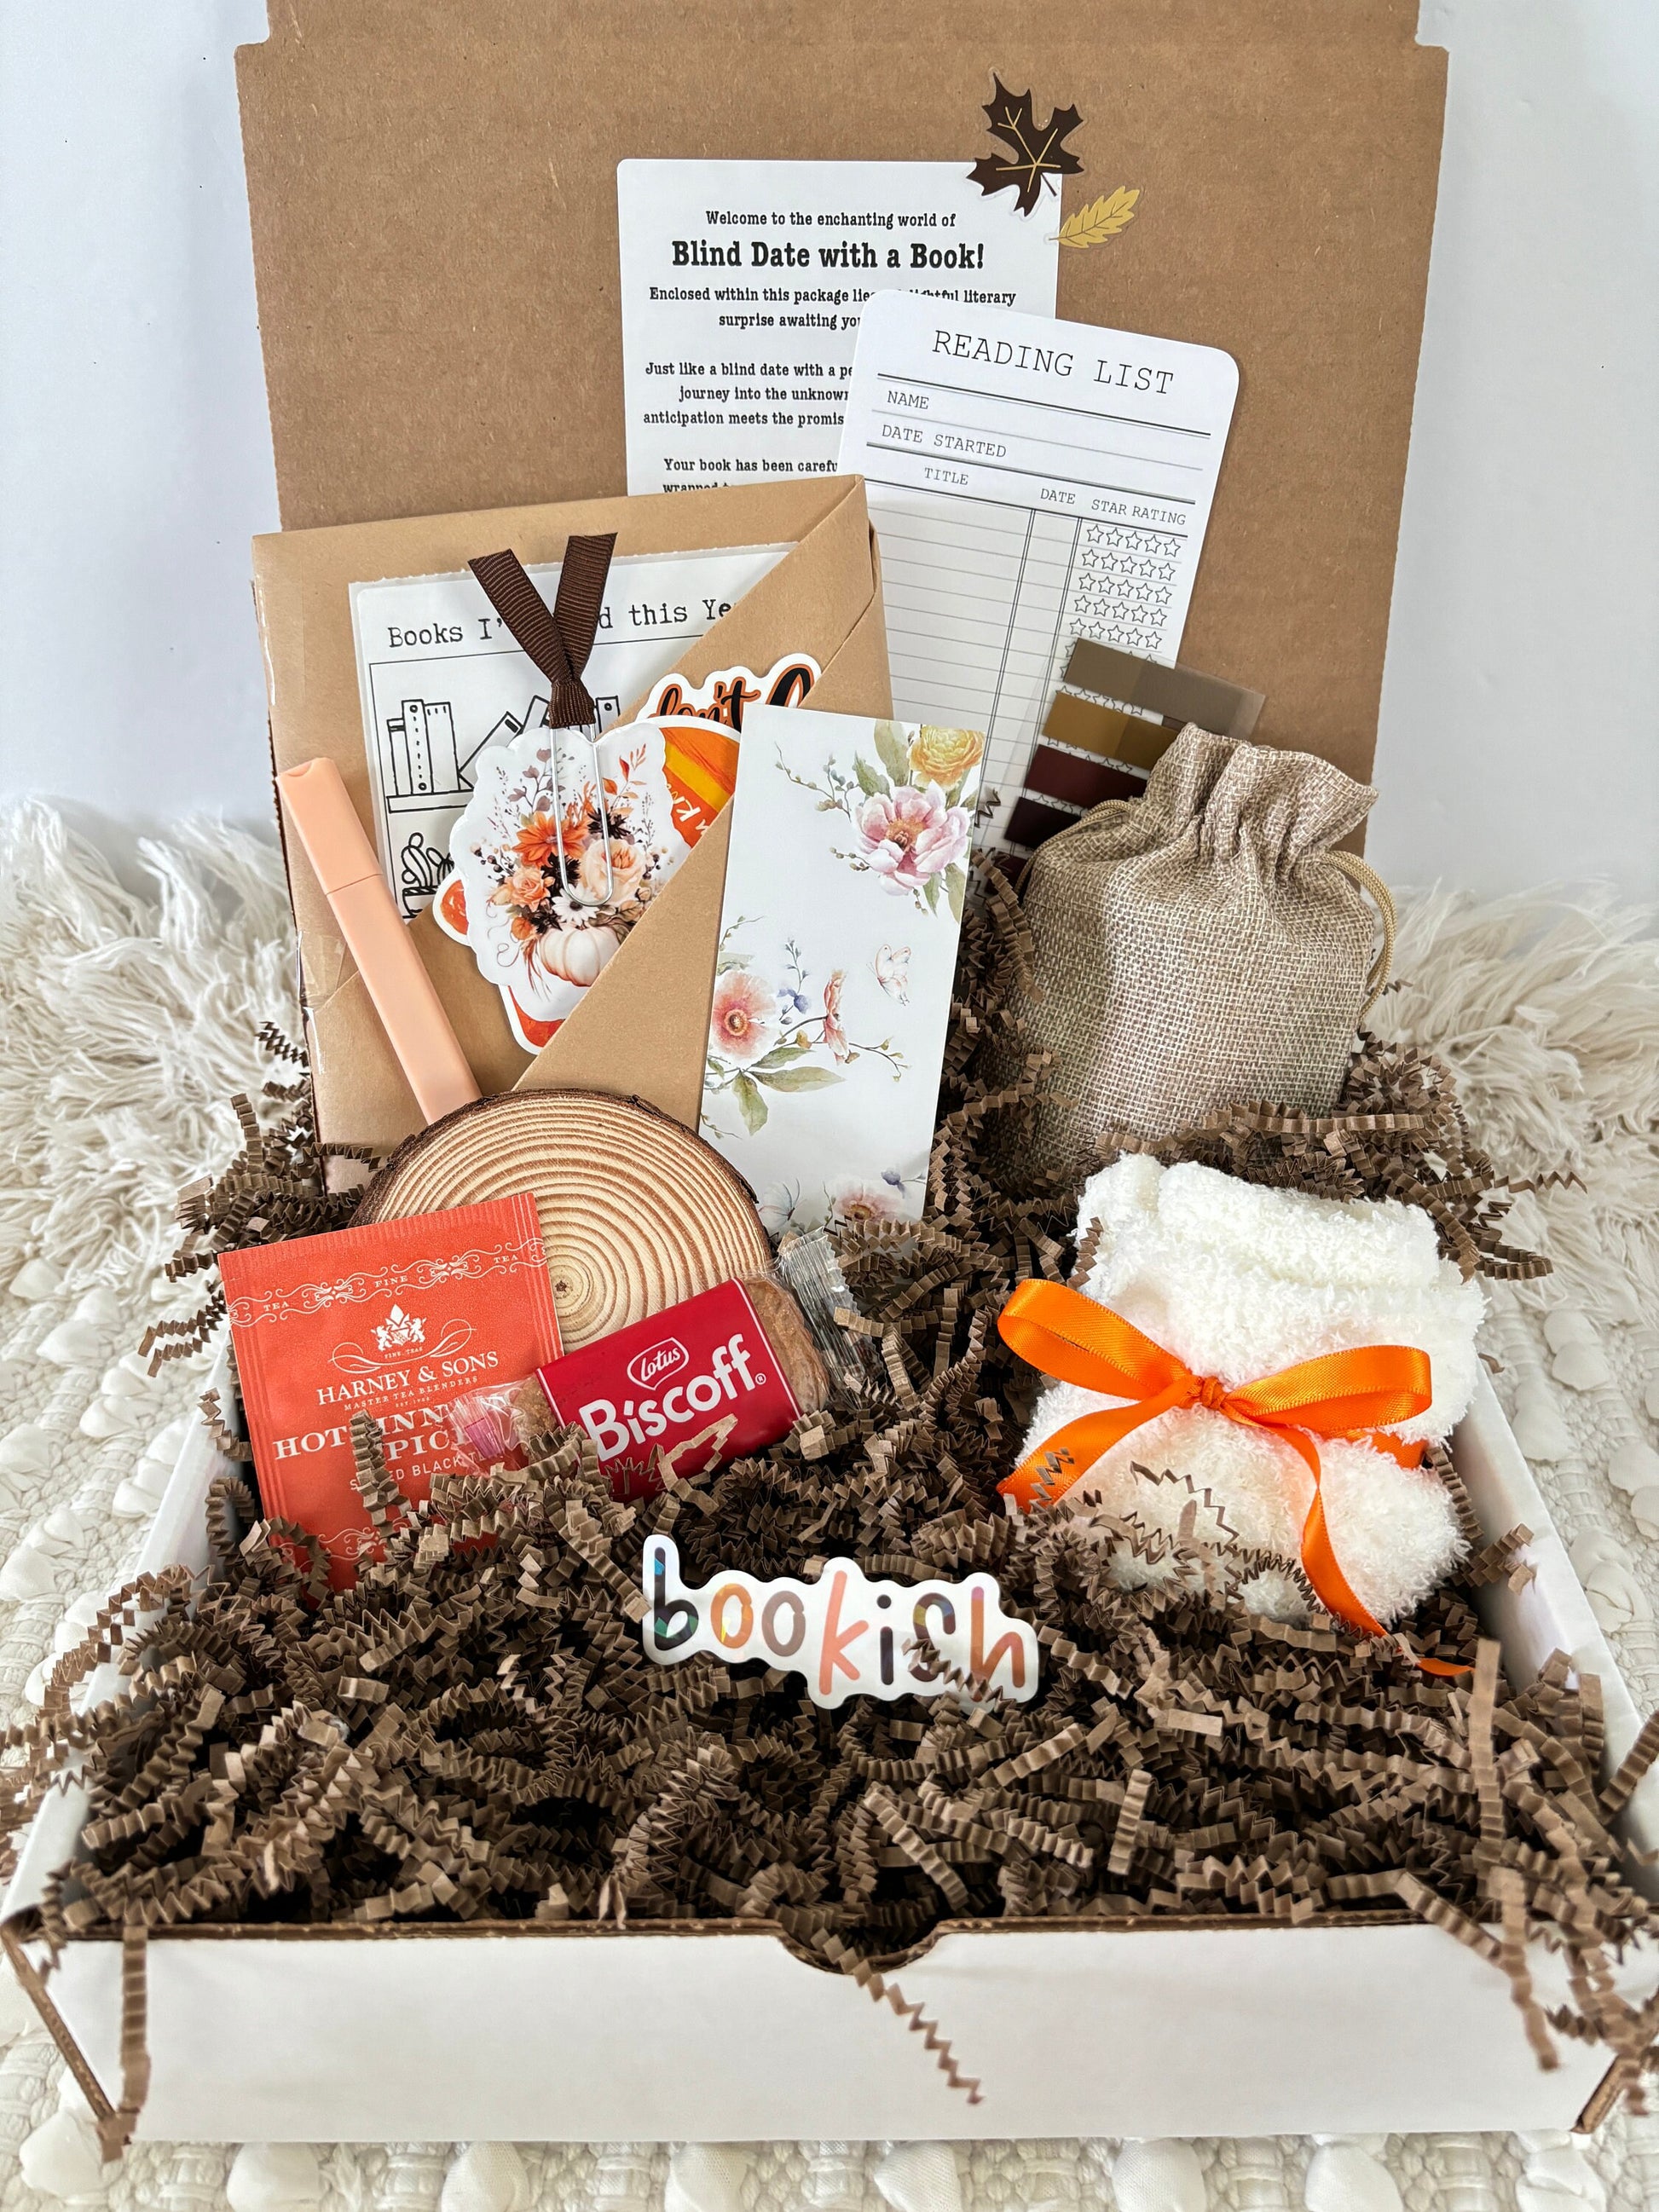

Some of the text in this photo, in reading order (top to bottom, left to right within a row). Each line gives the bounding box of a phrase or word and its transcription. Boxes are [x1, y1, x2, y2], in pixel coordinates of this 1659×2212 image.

[705, 210, 957, 230] Welcome to the enchanting world of
[671, 239, 984, 269] Blind Date with a Book!
[649, 286, 711, 301] Enclosed
[714, 287, 760, 301] within
[762, 287, 790, 302] this
[793, 288, 849, 306] package
[963, 289, 1017, 308] literary
[719, 312, 775, 330] surprise
[778, 313, 837, 331] awaiting
[645, 361, 675, 375] Just
[679, 361, 705, 376] like
[709, 365, 717, 376] a
[720, 362, 756, 376] blind
[760, 362, 789, 376] date
[793, 362, 824, 377] with
[828, 366, 836, 377] a
[932, 330, 1174, 395] READING LIST
[679, 384, 731, 403] journey
[734, 386, 761, 400] into
[765, 387, 787, 401] the
[887, 390, 929, 410] NAME
[643, 410, 845, 428] anticipation meets the promis
[882, 424, 1007, 458] DATE STARTED
[663, 458, 696, 471] Your
[699, 458, 731, 471] book
[735, 459, 758, 471] has
[761, 459, 794, 472] been
[924, 467, 1187, 526] TITLE DATE STAR RATING
[389, 623, 464, 648] Books
[629, 604, 688, 627] this
[263, 1255, 518, 1312] TEA FINE TEA
[316, 1369, 410, 1406] HARNEY
[418, 1366, 438, 1383] &
[442, 1351, 499, 1377] SONS
[639, 1344, 684, 1382] Lotus
[344, 1395, 389, 1411] MASTER
[393, 1389, 415, 1400] TEA
[419, 1376, 478, 1395] BLENDERS
[580, 1334, 755, 1461] Biscoff
[272, 1426, 347, 1460] HOT
[412, 1456, 461, 1476] BLACK
[654, 1547, 1026, 1702] bookish
